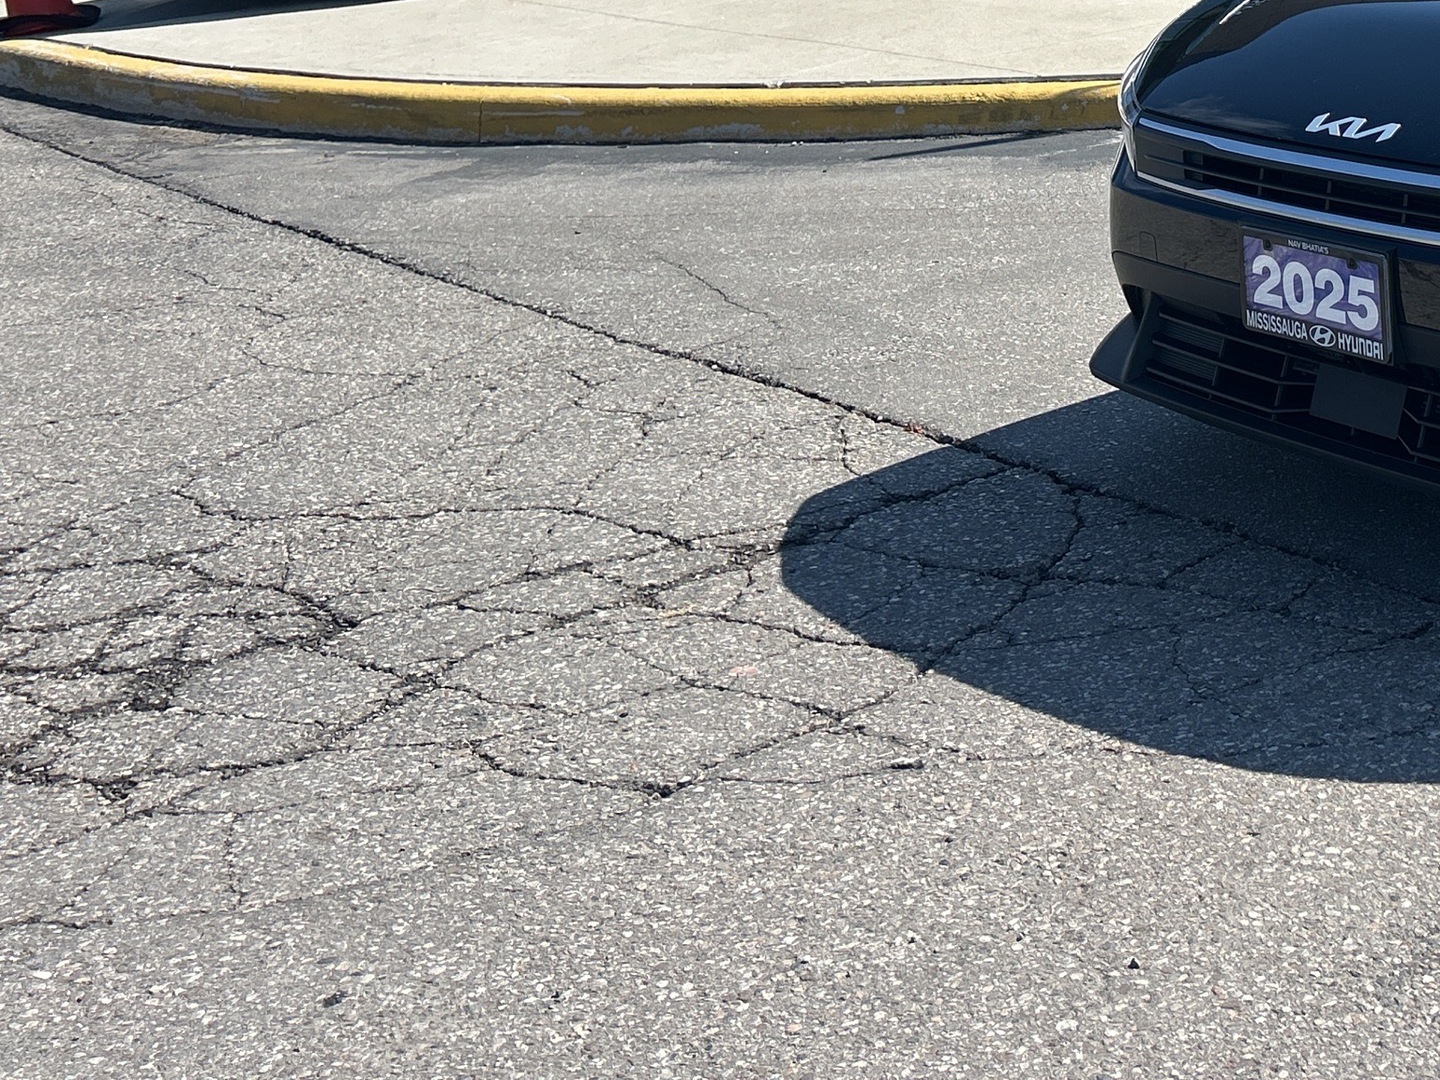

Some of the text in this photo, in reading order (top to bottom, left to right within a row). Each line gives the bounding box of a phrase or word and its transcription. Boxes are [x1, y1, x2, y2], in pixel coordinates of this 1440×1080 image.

[1287, 239, 1301, 249] NAV
[1252, 254, 1379, 332] 2025
[1246, 309, 1384, 360] MISSISSAUGA HYUNDAI
